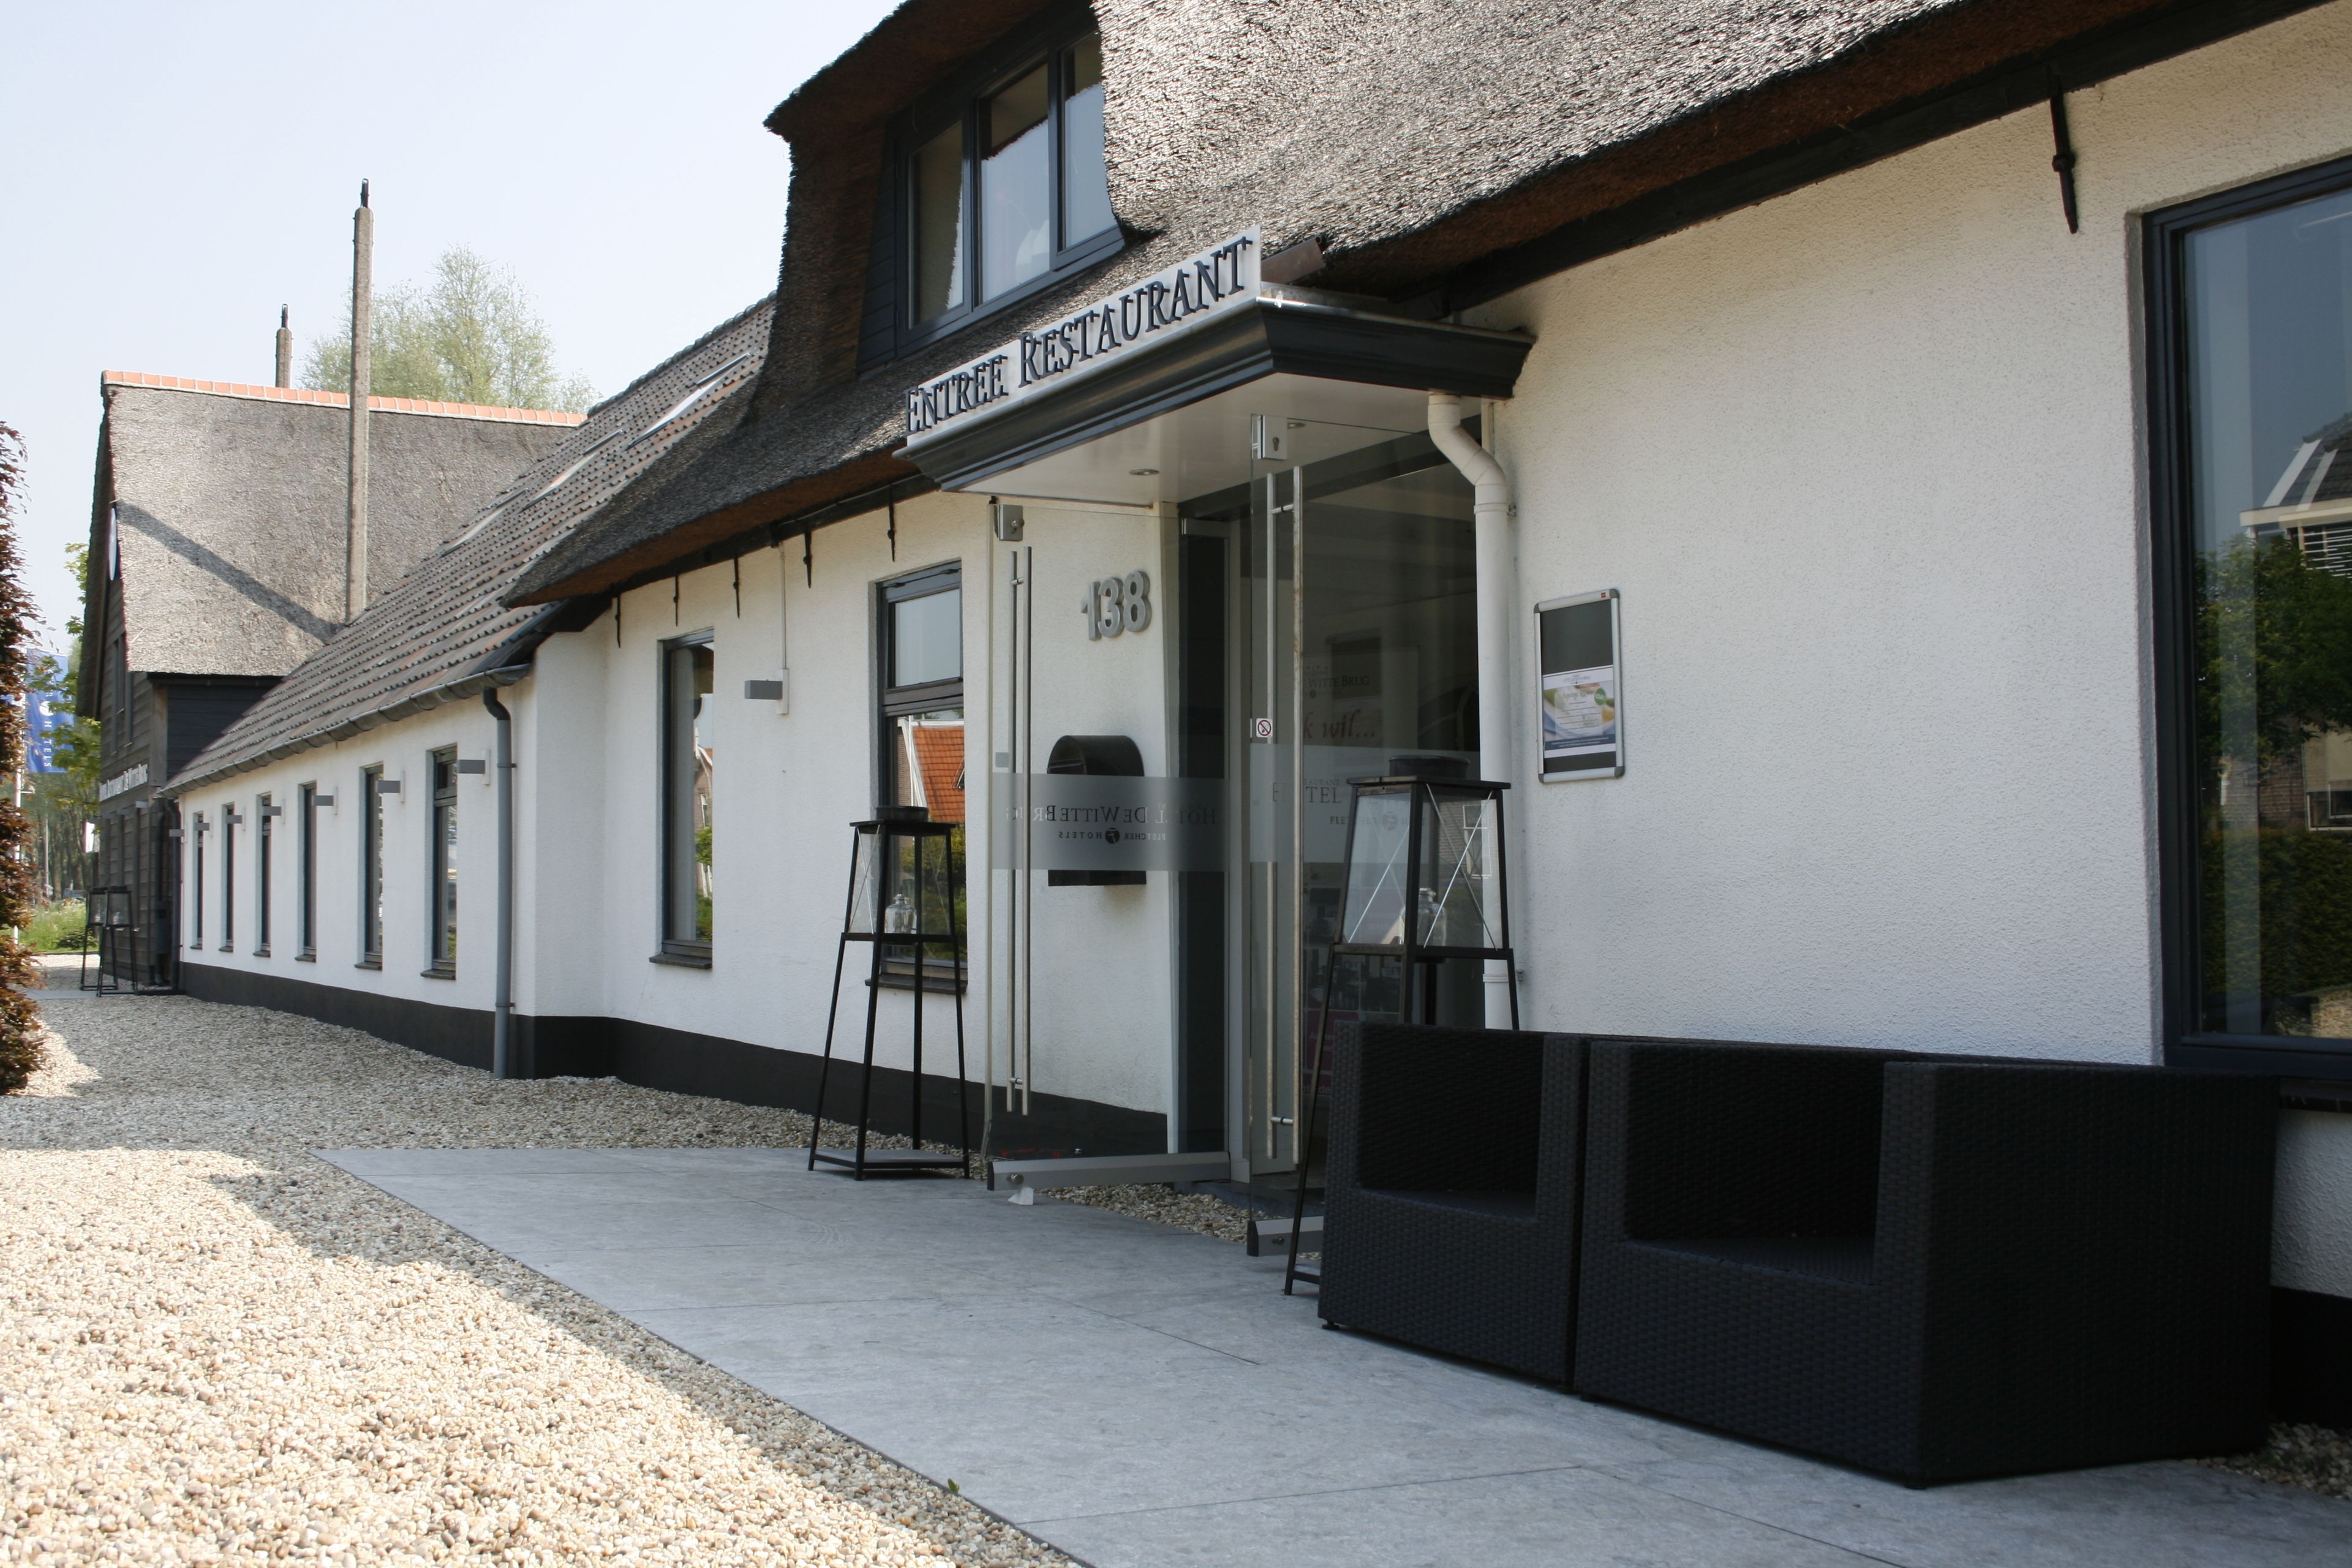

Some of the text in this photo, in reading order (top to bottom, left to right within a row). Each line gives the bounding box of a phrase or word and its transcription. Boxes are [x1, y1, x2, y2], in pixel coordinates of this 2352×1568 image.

[903, 236, 1253, 437] ENTREE RESTAURANT
[1080, 570, 1152, 641] 138
[1341, 675, 1371, 687] BRUG
[43, 720, 53, 767] HTELS
